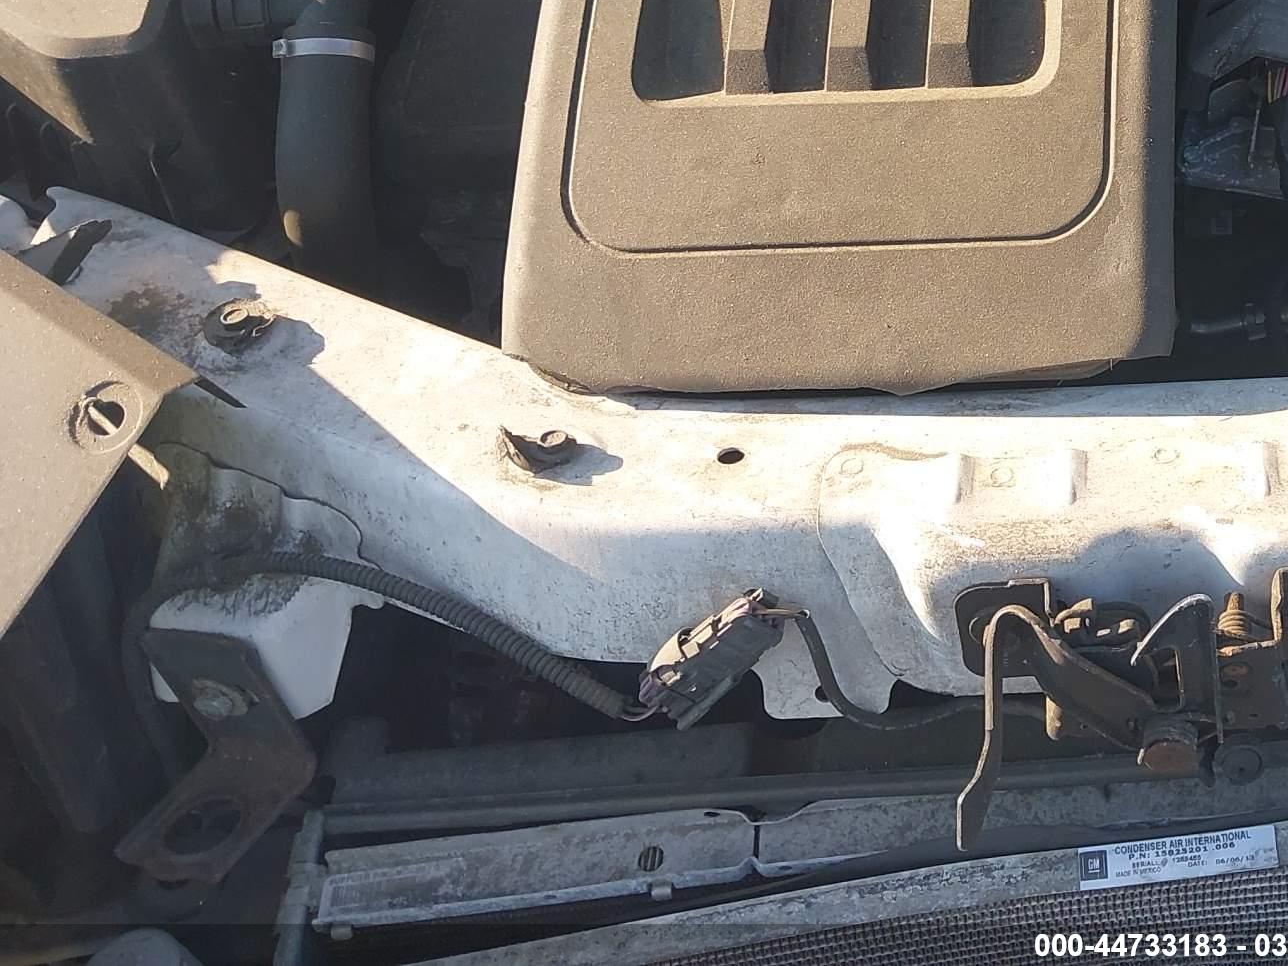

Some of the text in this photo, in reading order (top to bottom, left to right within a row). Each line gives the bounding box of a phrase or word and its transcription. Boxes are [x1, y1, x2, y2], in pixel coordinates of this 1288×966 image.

[1114, 830, 1252, 855] CONDENSER AIR INTERNATIONAL
[1088, 858, 1100, 870] GM
